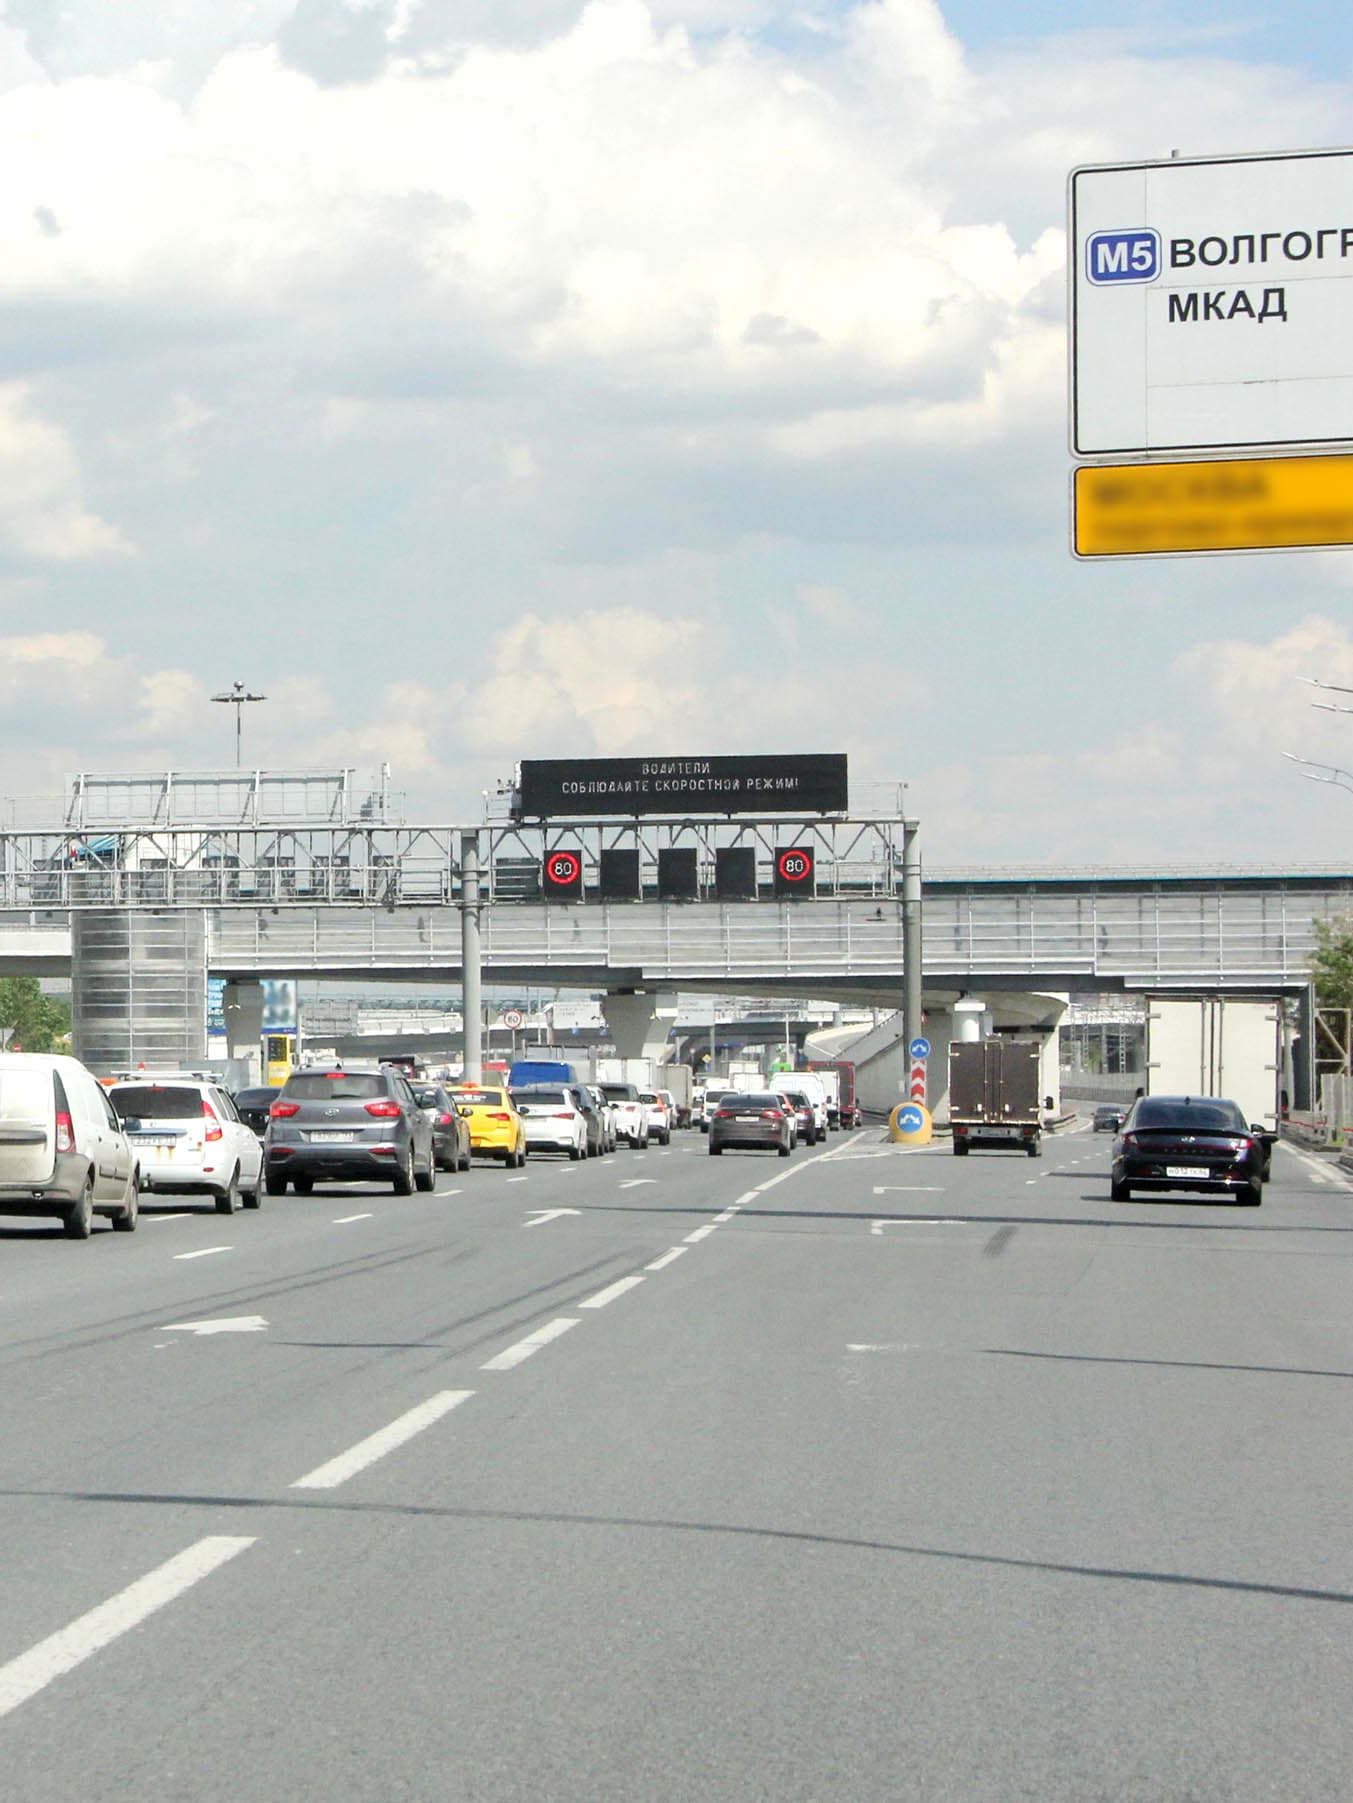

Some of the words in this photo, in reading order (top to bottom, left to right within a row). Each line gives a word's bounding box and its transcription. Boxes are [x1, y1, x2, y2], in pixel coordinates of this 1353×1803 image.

[1096, 240, 1154, 274] М5
[1169, 227, 1353, 269] ВОЛГОГР
[1167, 286, 1288, 324] МКАД
[641, 761, 711, 776] ВОДИТЕЛИ
[561, 779, 649, 794] СОБЛЮДАЙТЕ
[654, 778, 741, 793] СКОРОСТНОЙ
[554, 861, 572, 876] 80
[785, 859, 804, 873] 80
